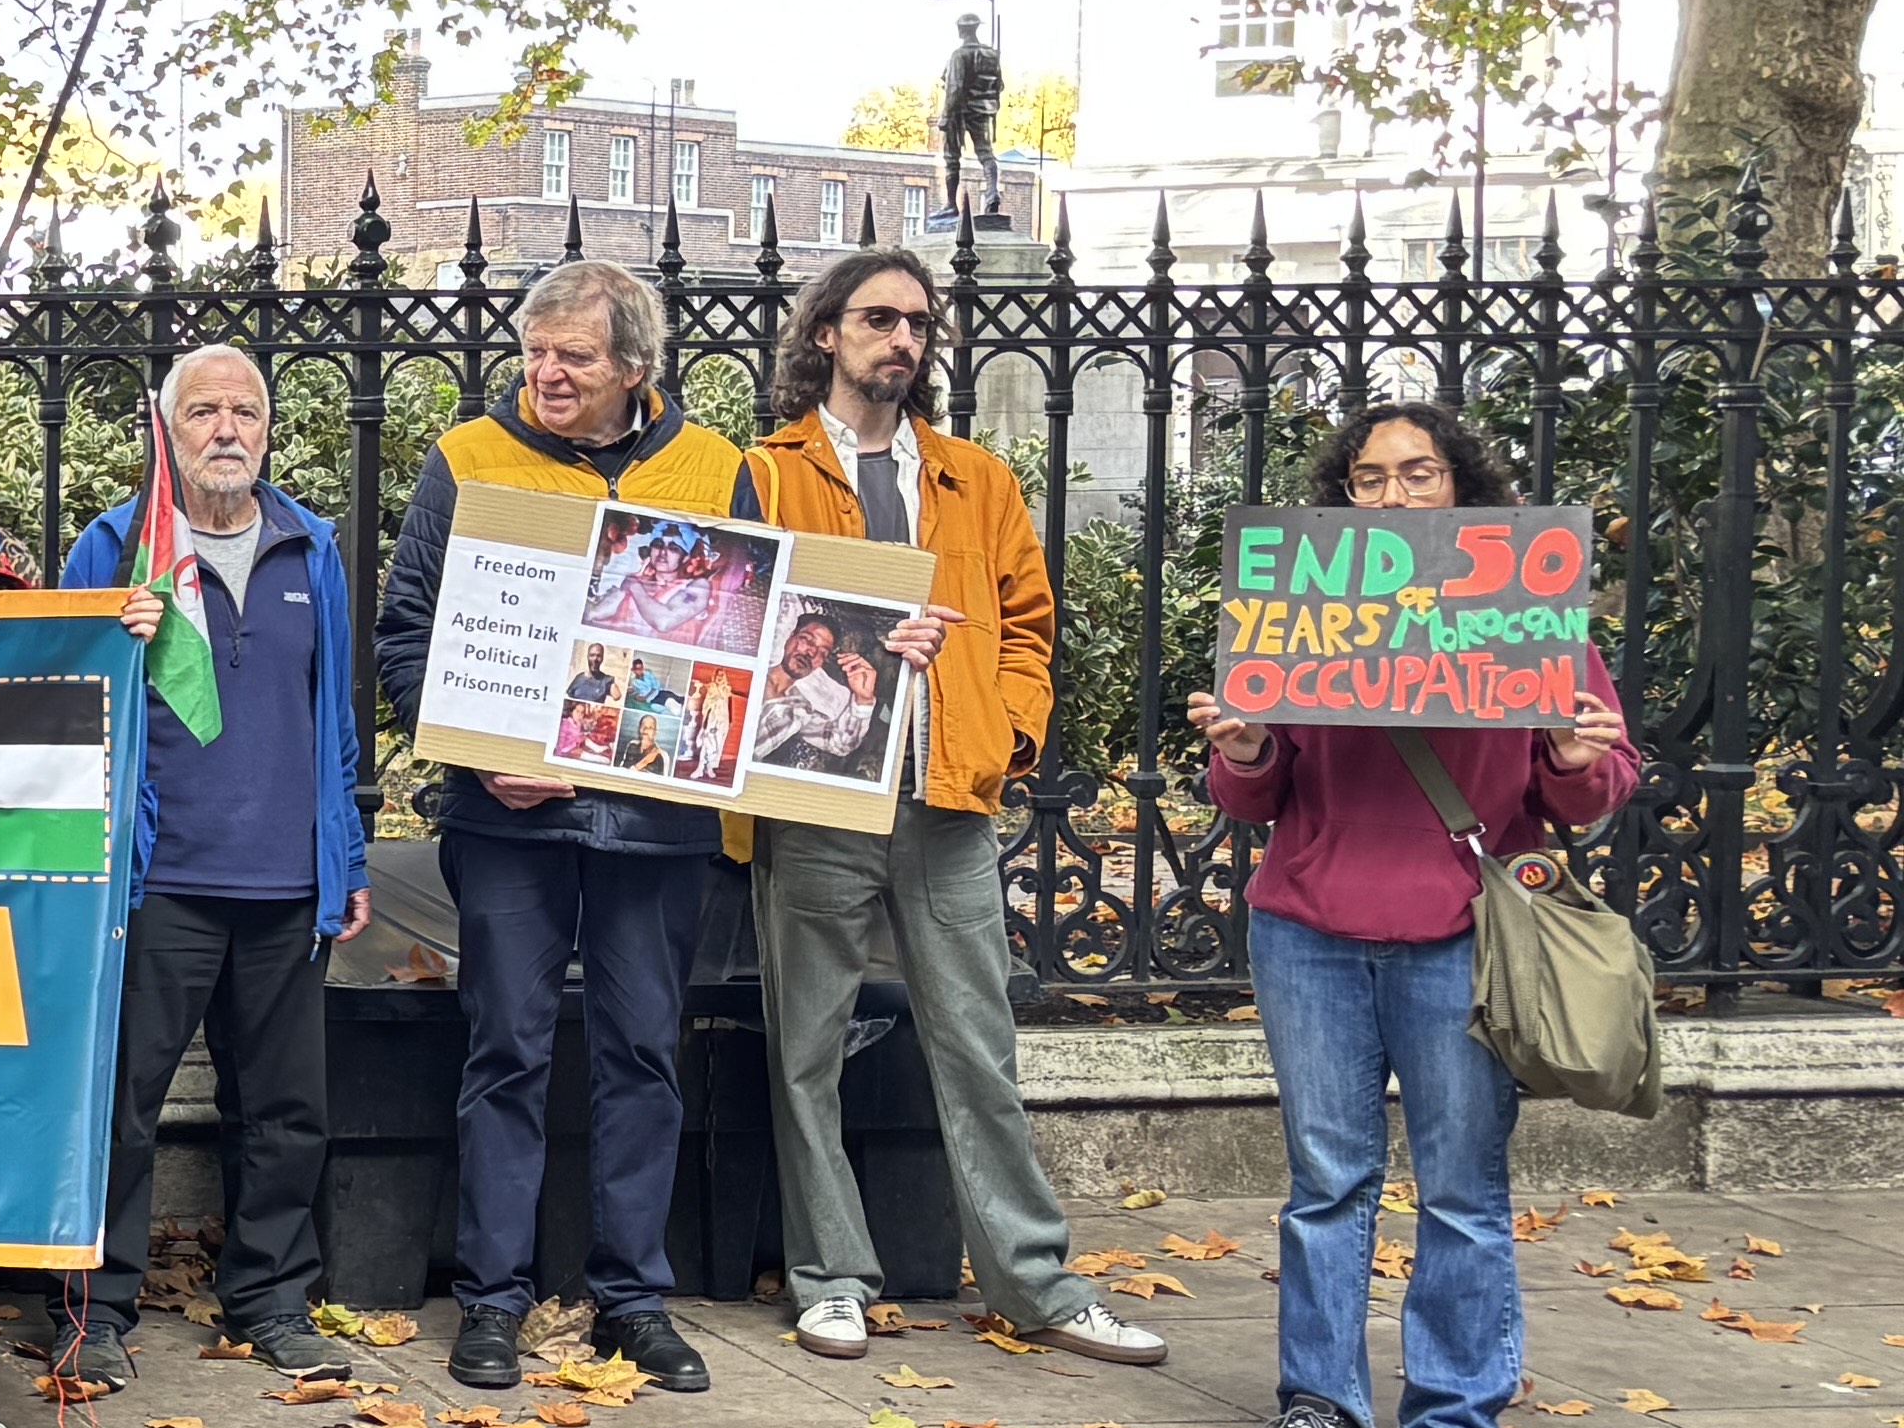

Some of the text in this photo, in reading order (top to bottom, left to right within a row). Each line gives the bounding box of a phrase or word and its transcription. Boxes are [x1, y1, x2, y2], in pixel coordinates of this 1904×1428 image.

[474, 555, 556, 582] Freedom
[1238, 523, 1584, 597] END 50
[500, 590, 520, 606] to
[451, 611, 559, 643] Agdeim Izik
[1222, 598, 1390, 657] YEARS
[464, 643, 538, 669] Political
[443, 670, 549, 701] Prisonners!
[1223, 652, 1576, 720] OCCUPATION
